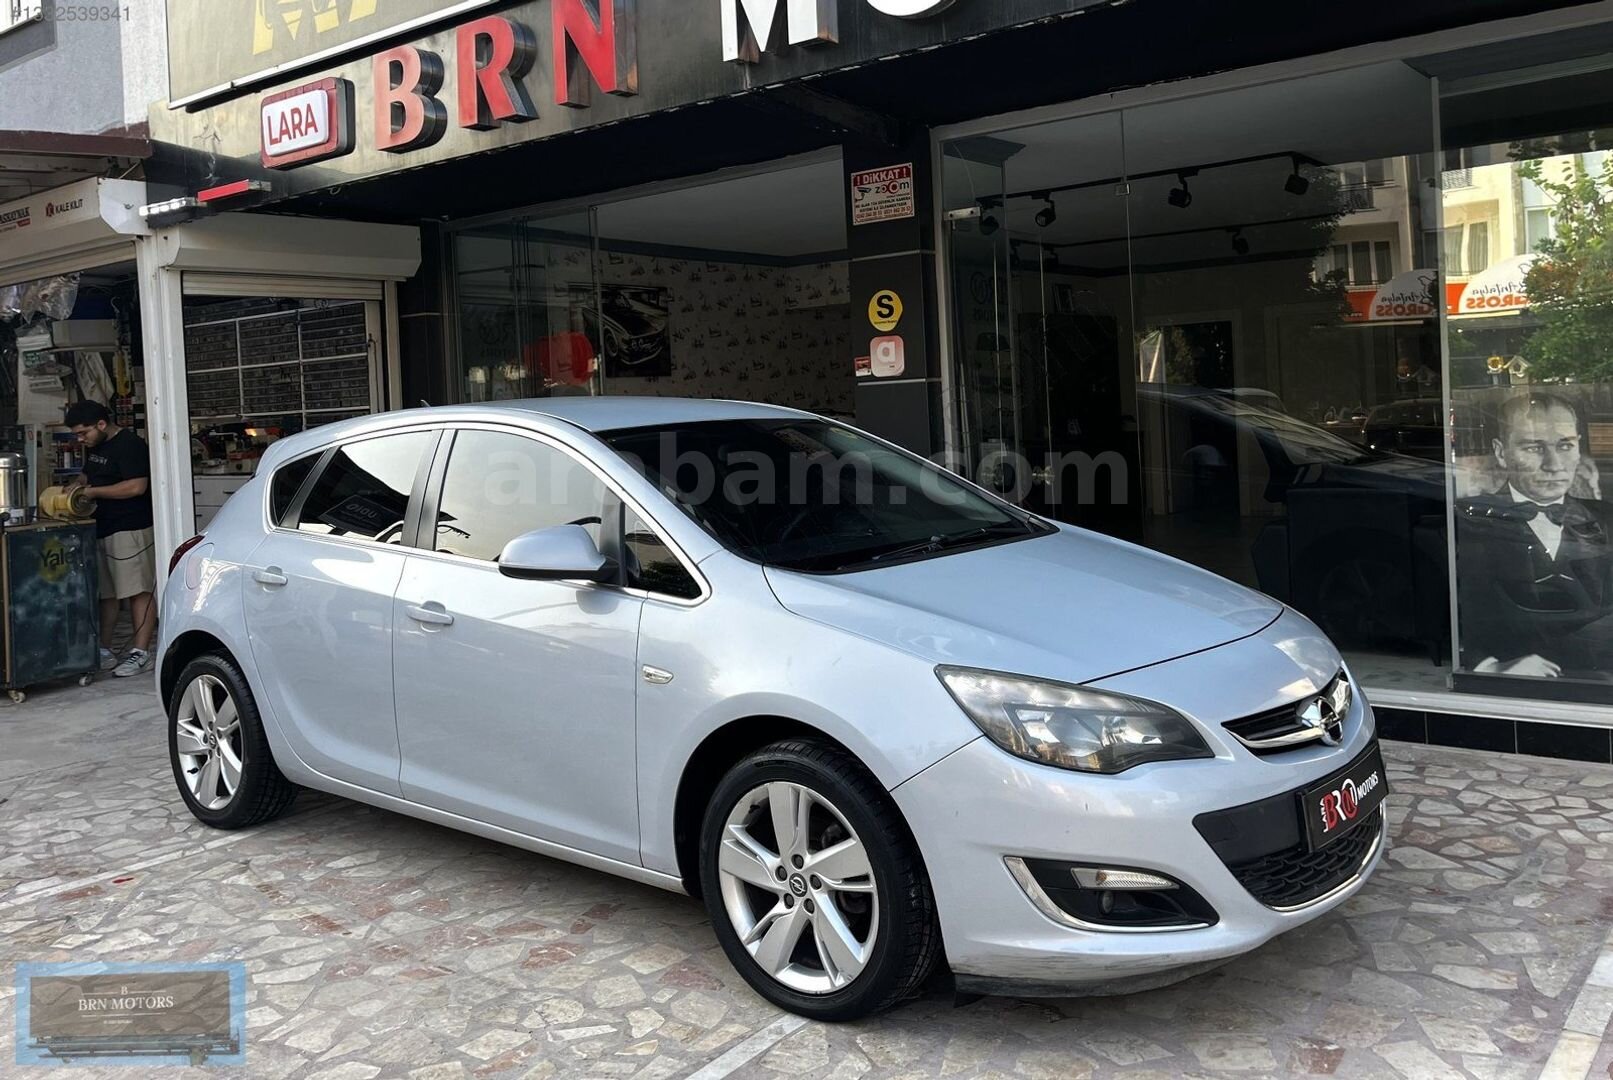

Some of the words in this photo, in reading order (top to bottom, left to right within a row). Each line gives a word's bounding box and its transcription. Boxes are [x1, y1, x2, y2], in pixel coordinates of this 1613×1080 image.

[372, 0, 638, 152] BRN
[267, 103, 318, 146] LARA
[876, 294, 895, 319] S
[39, 547, 74, 568] Yale
[1356, 771, 1379, 800] MOTORS
